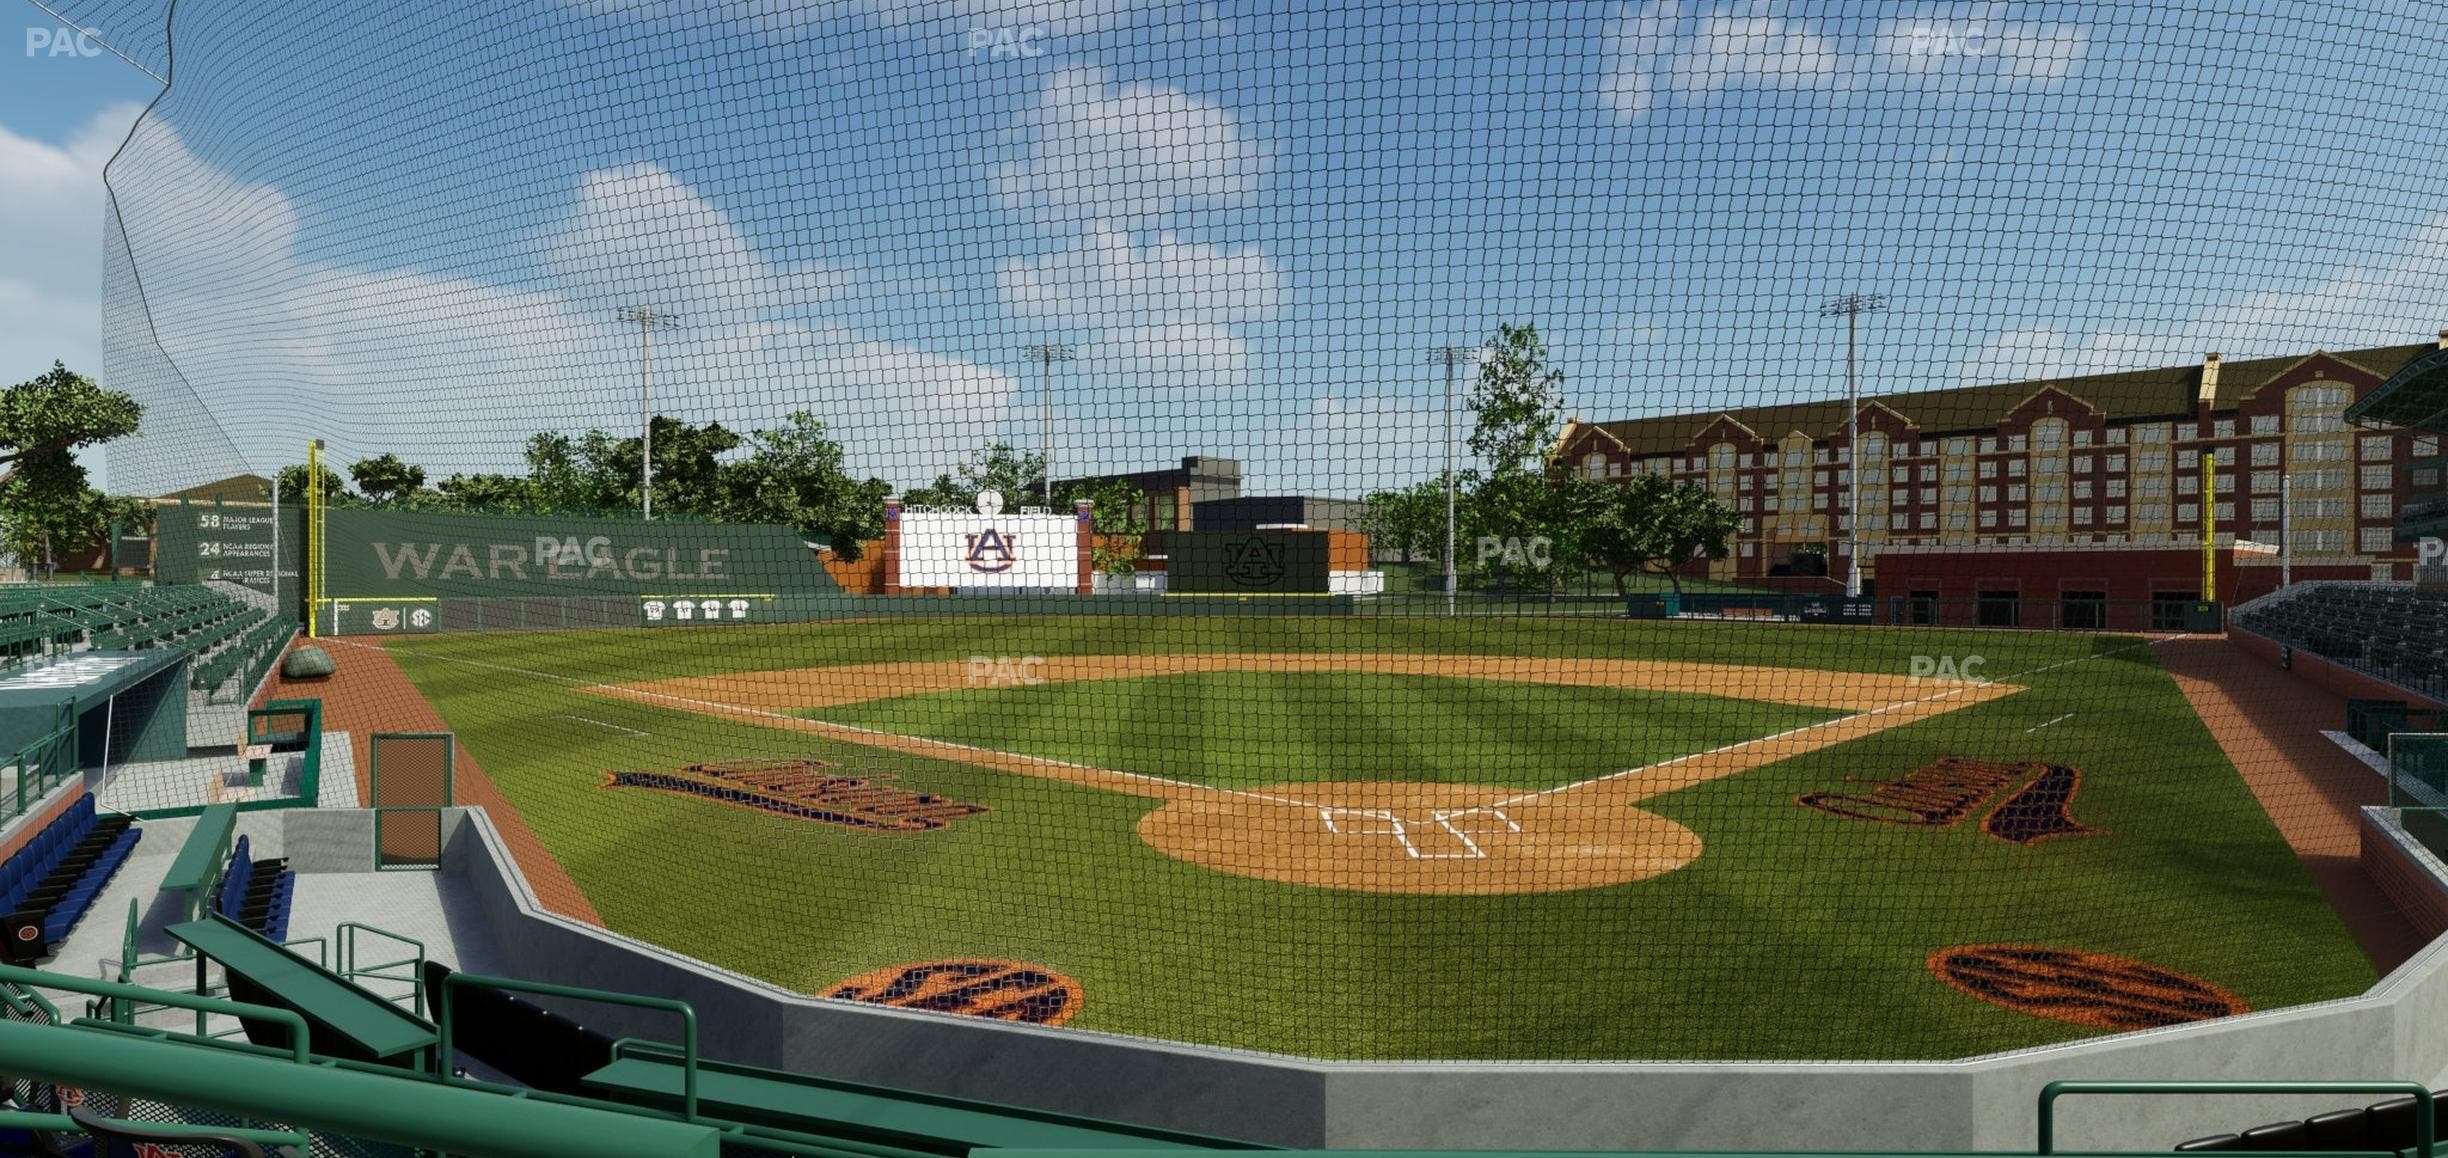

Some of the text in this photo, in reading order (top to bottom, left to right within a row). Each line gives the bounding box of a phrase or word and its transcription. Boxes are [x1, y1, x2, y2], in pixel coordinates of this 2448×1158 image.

[905, 504, 1052, 515] HITCHCOCK FIELD
[200, 515, 220, 528] 58
[223, 516, 247, 524] MAJOR
[200, 542, 220, 556] 24
[371, 543, 730, 580] WAR EAGLE
